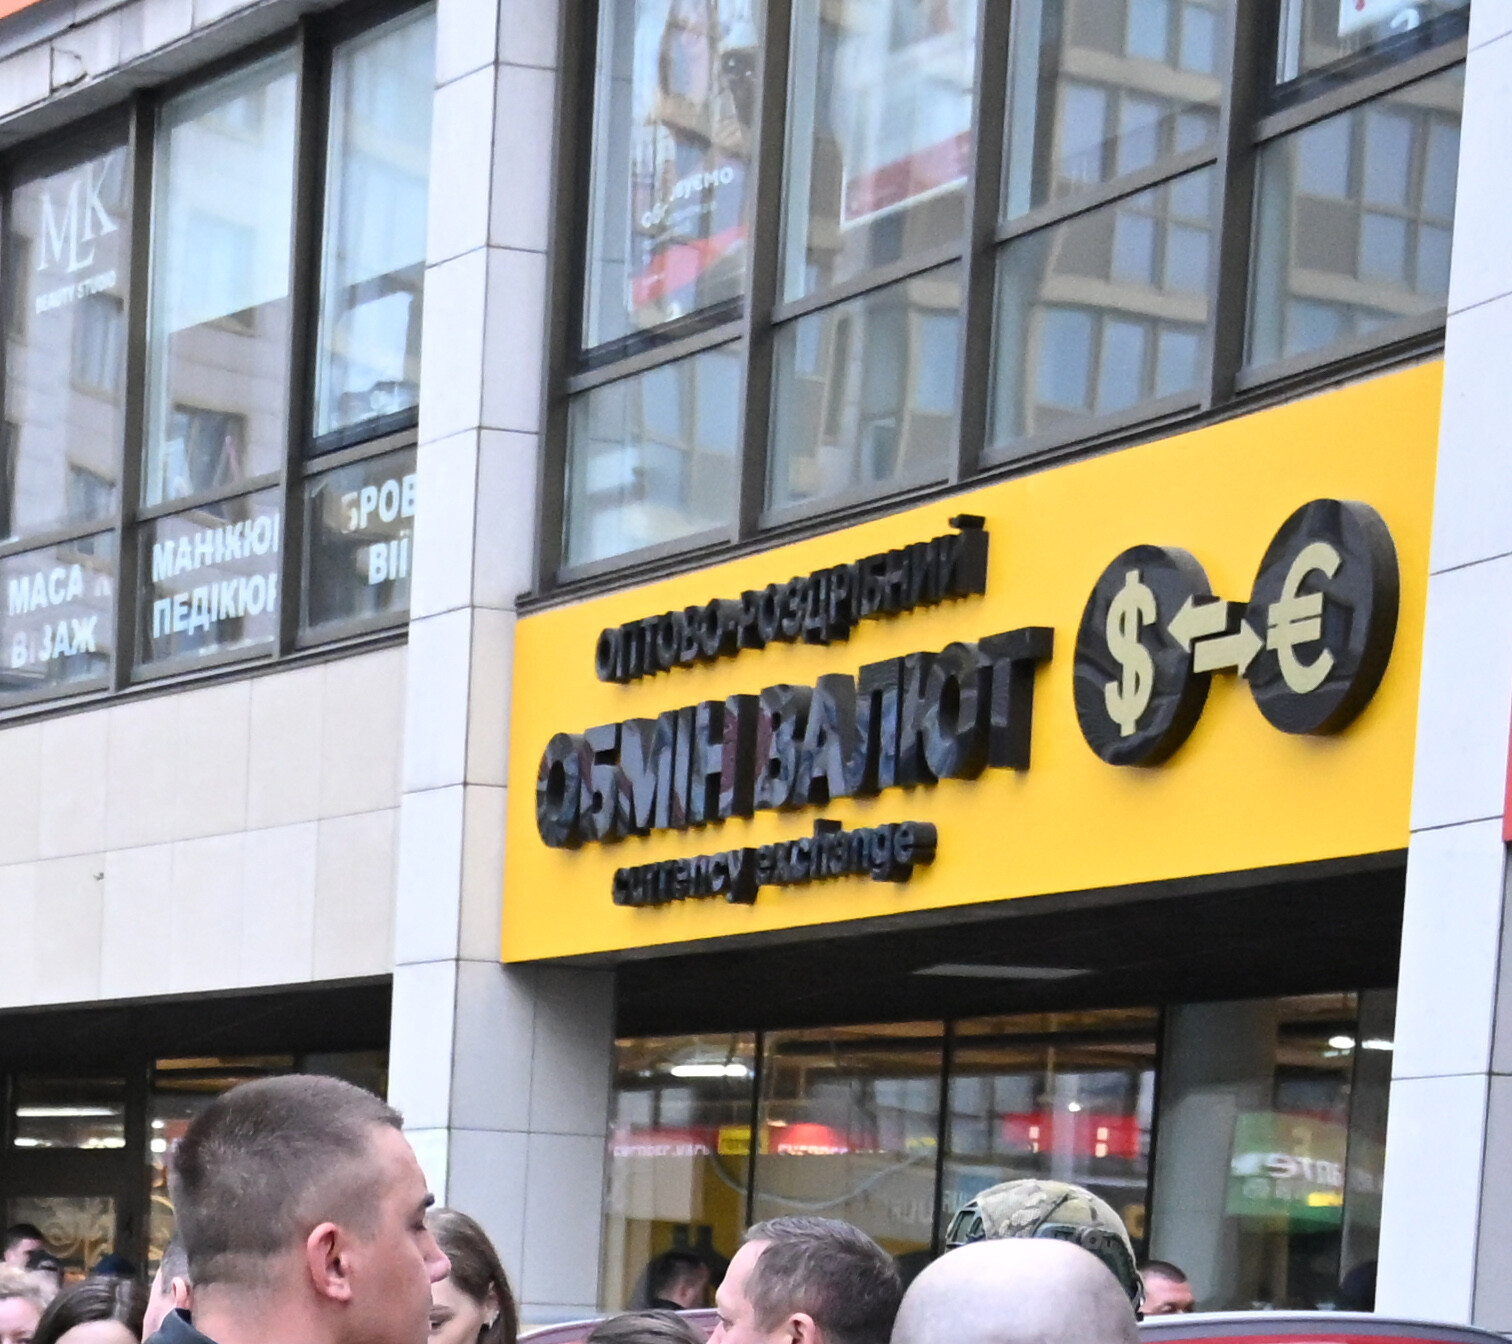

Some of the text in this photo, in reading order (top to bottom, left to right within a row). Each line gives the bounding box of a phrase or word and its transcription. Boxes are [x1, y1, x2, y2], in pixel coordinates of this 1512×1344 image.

[595, 513, 990, 684] ОПТОВО-РОЗДРІБНИЙ
[536, 626, 1055, 850] ОБМІН ВАЛЮТ
[612, 818, 939, 907] currency exchange
